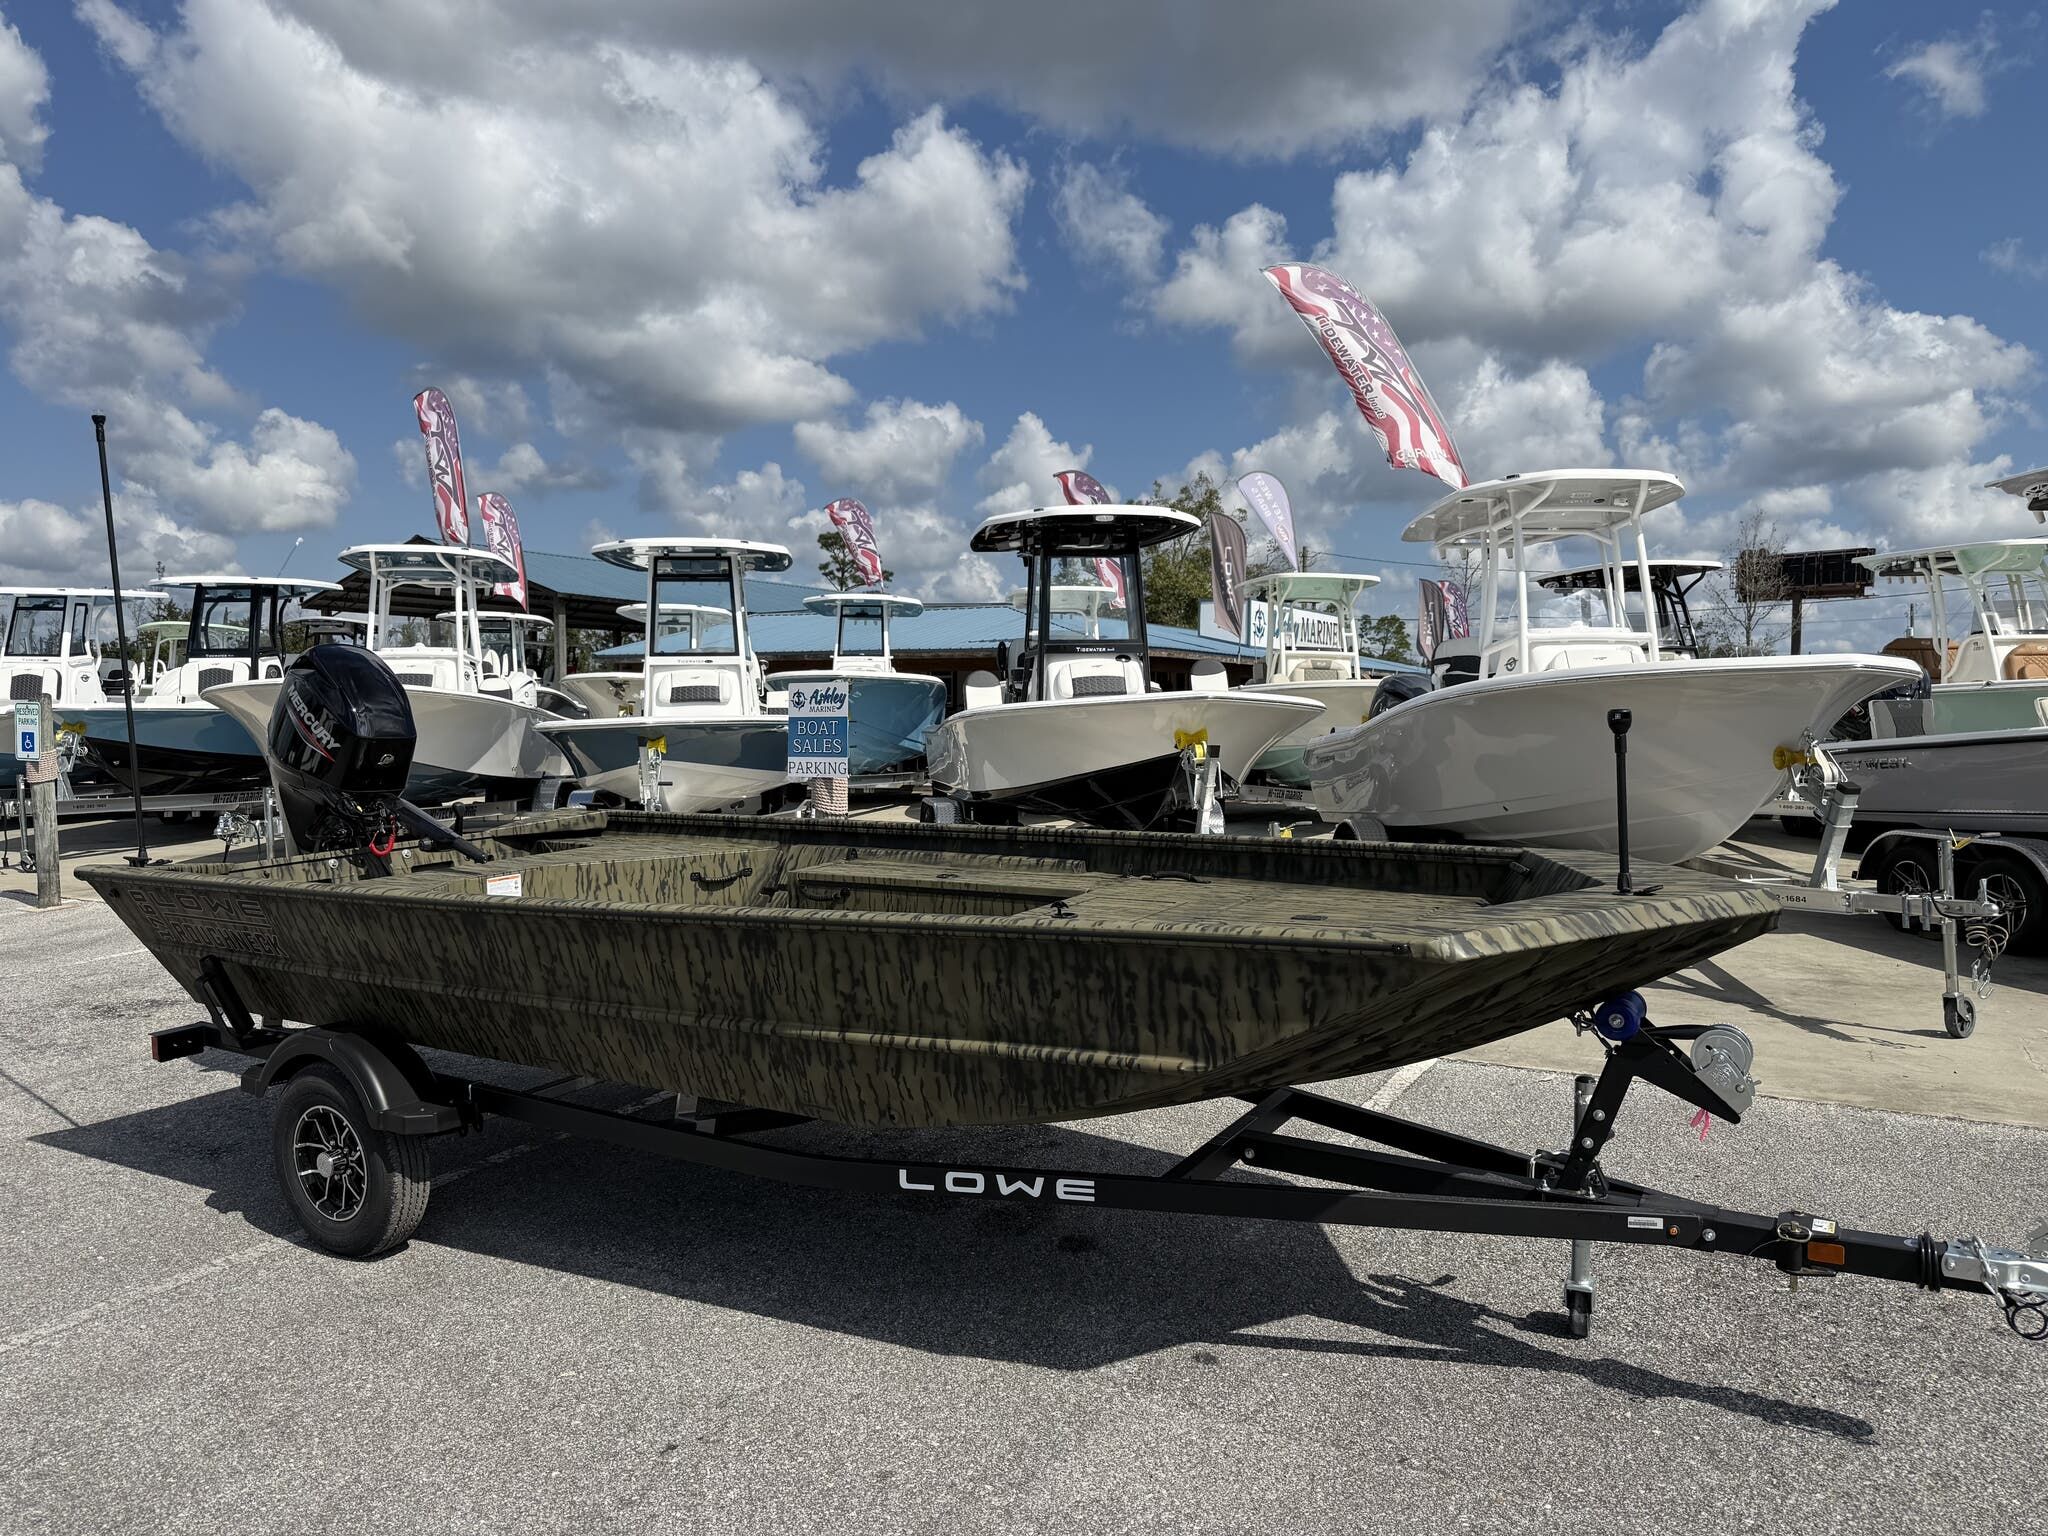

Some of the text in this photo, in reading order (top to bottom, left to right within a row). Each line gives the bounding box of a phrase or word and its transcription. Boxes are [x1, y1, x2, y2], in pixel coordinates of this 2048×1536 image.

[1315, 315, 1374, 395] TIDEWATER
[1300, 616, 1338, 646] MARINE
[809, 686, 847, 710] Ashley
[809, 705, 837, 713] MARINE
[18, 717, 38, 726] PARKING
[287, 684, 342, 750] MERCURY
[797, 720, 838, 735] BOAT
[793, 738, 842, 753] SALES
[788, 761, 847, 775] PARKING
[148, 890, 267, 920] LOWE
[170, 921, 290, 960] ROUGHNECK
[899, 1169, 1095, 1202] LOWE
